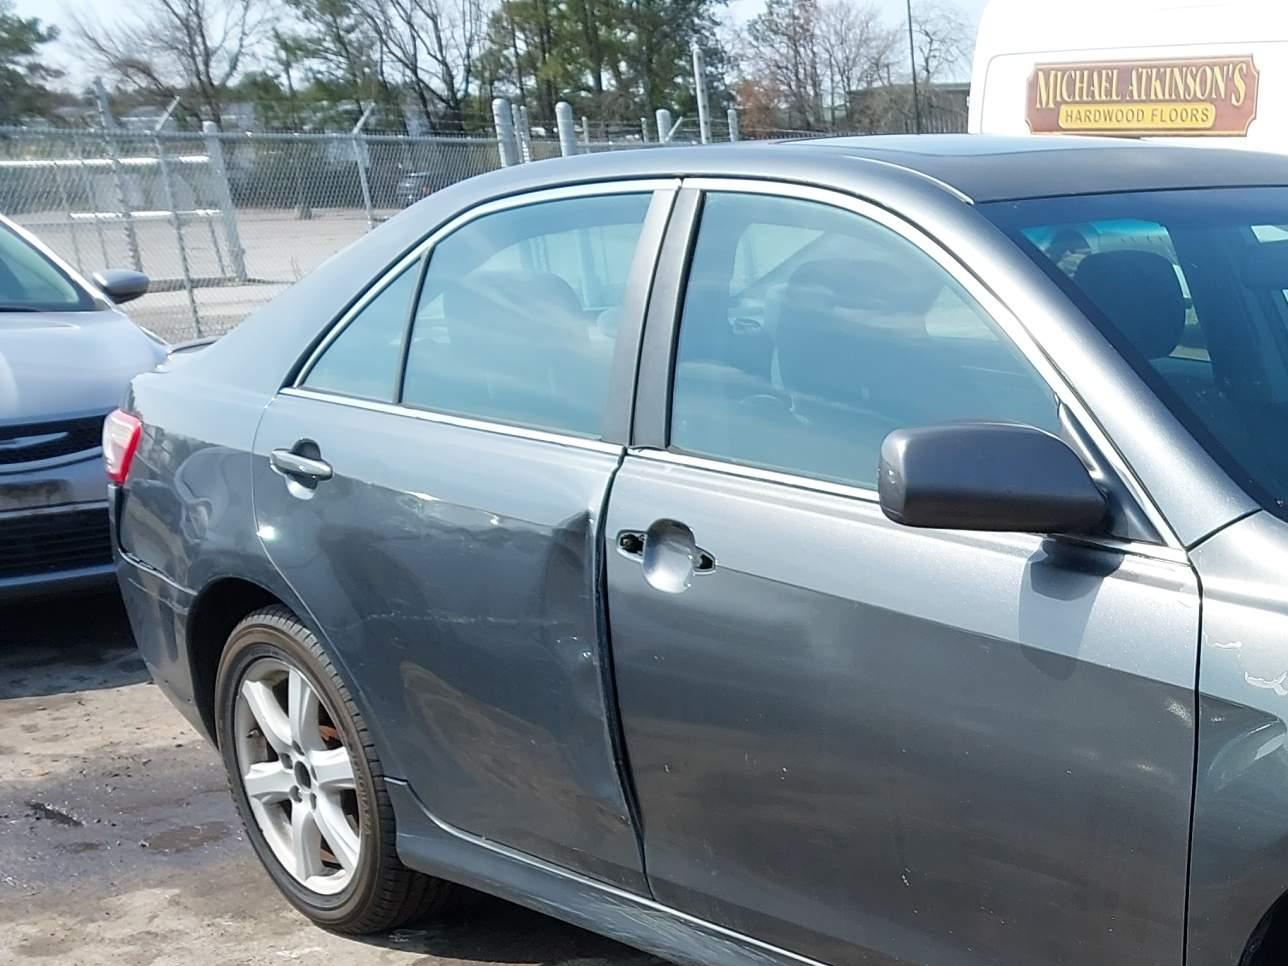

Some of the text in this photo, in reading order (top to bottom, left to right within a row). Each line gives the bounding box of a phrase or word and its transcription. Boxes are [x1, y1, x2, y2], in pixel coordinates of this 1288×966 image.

[1036, 63, 1248, 108] MICHAEL ATKINSON'S
[1065, 107, 1210, 124] HARDWOOD FLOORS
